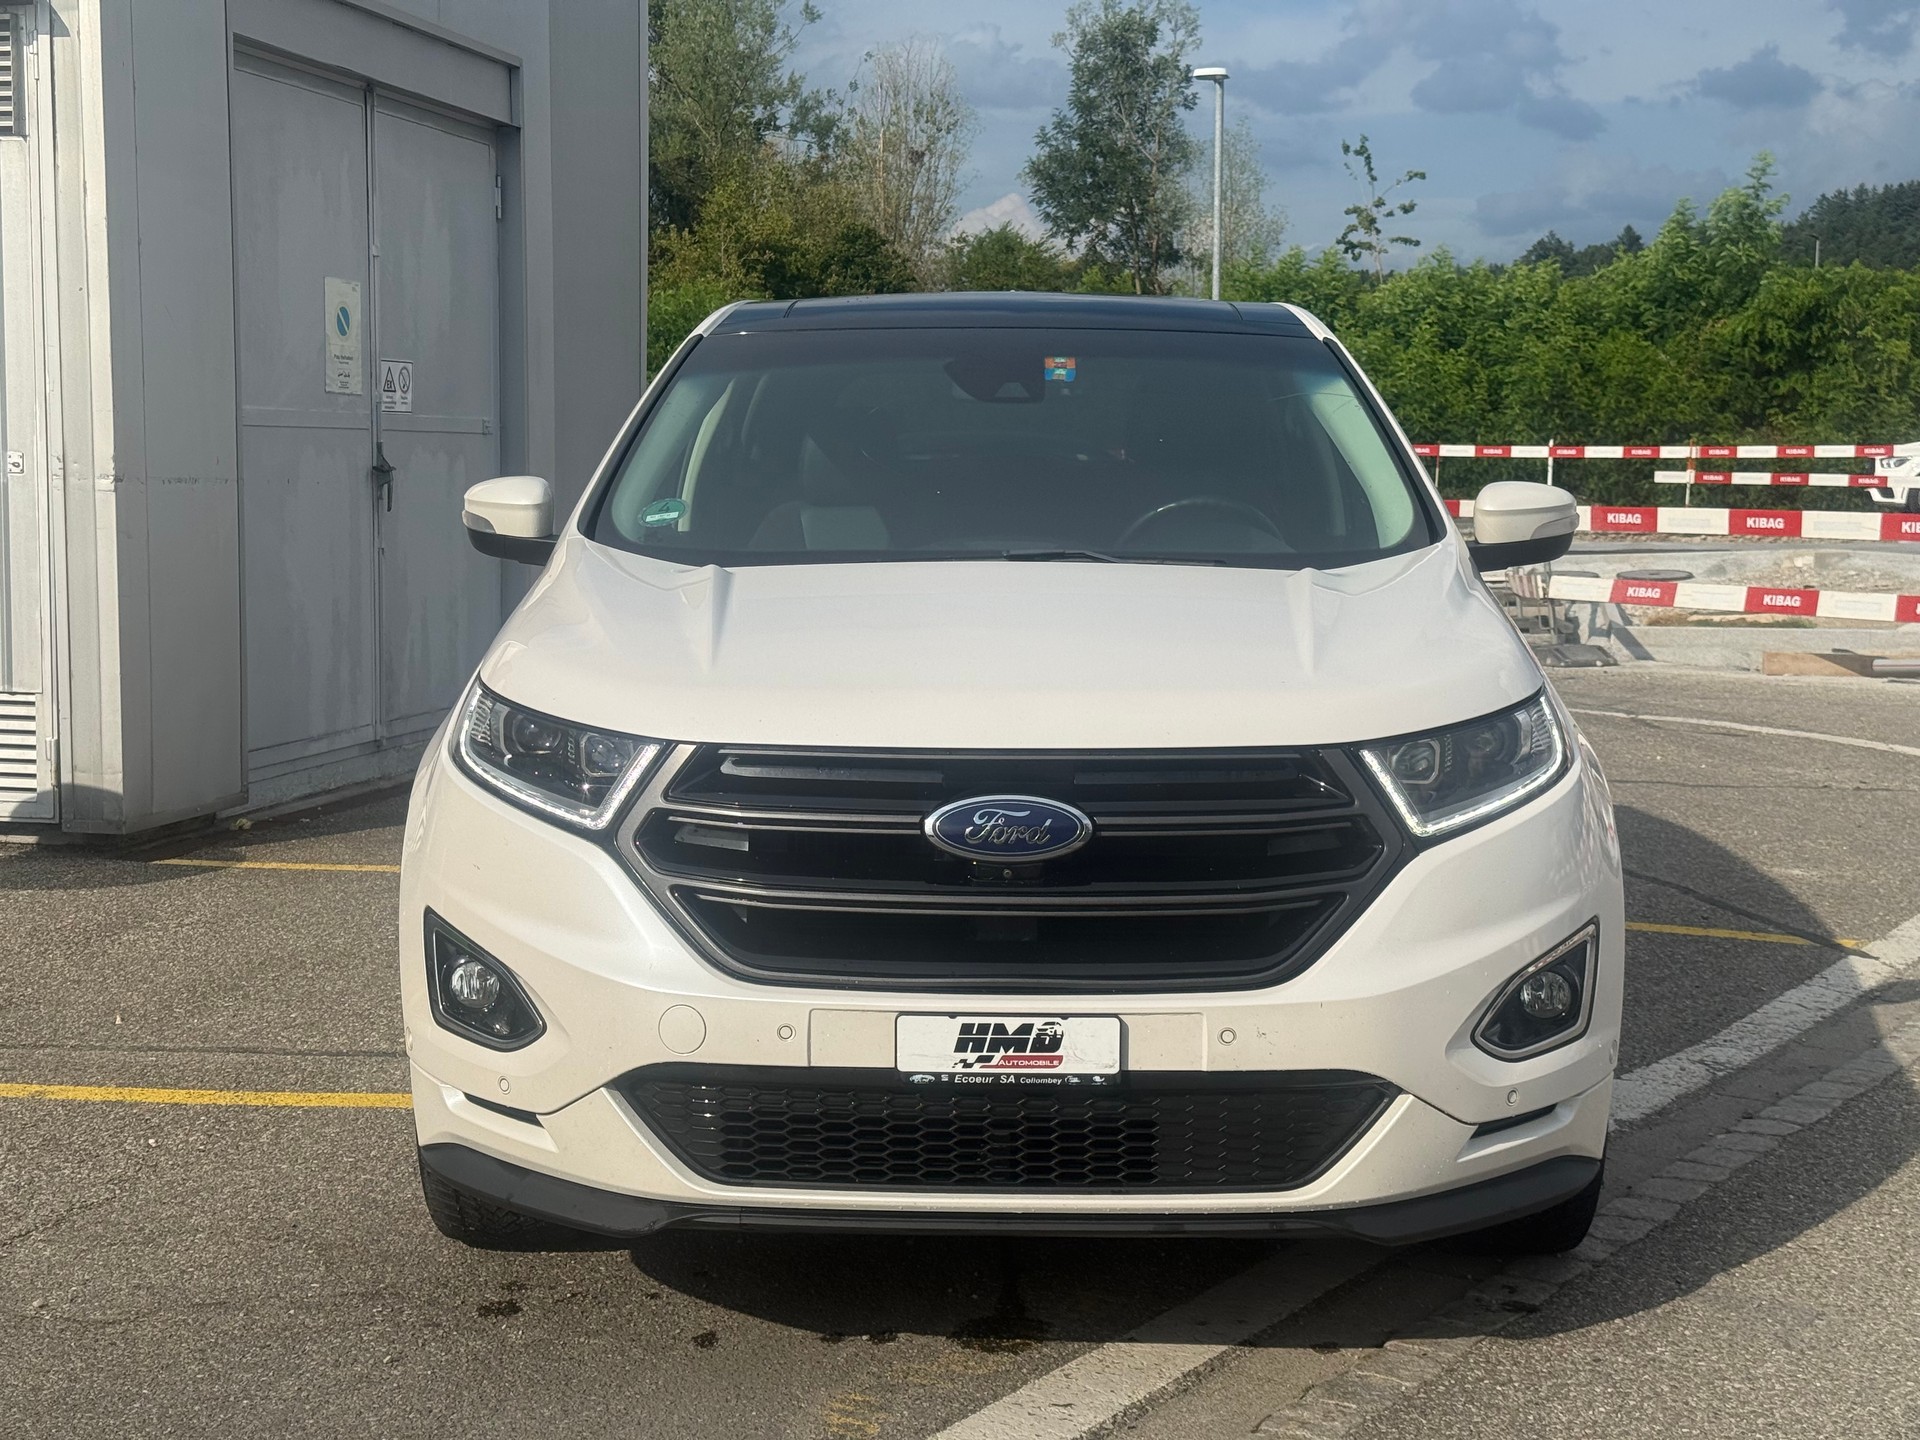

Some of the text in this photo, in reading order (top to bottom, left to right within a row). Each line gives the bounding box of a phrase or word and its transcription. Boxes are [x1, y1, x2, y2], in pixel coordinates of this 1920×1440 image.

[1607, 513, 1920, 534] KIBAG KIBAG KIB
[1627, 586, 1801, 607] KIBAG KIBAG
[965, 808, 1053, 844] Ford
[954, 1074, 1063, 1085] Ecoeur SA Collombey
